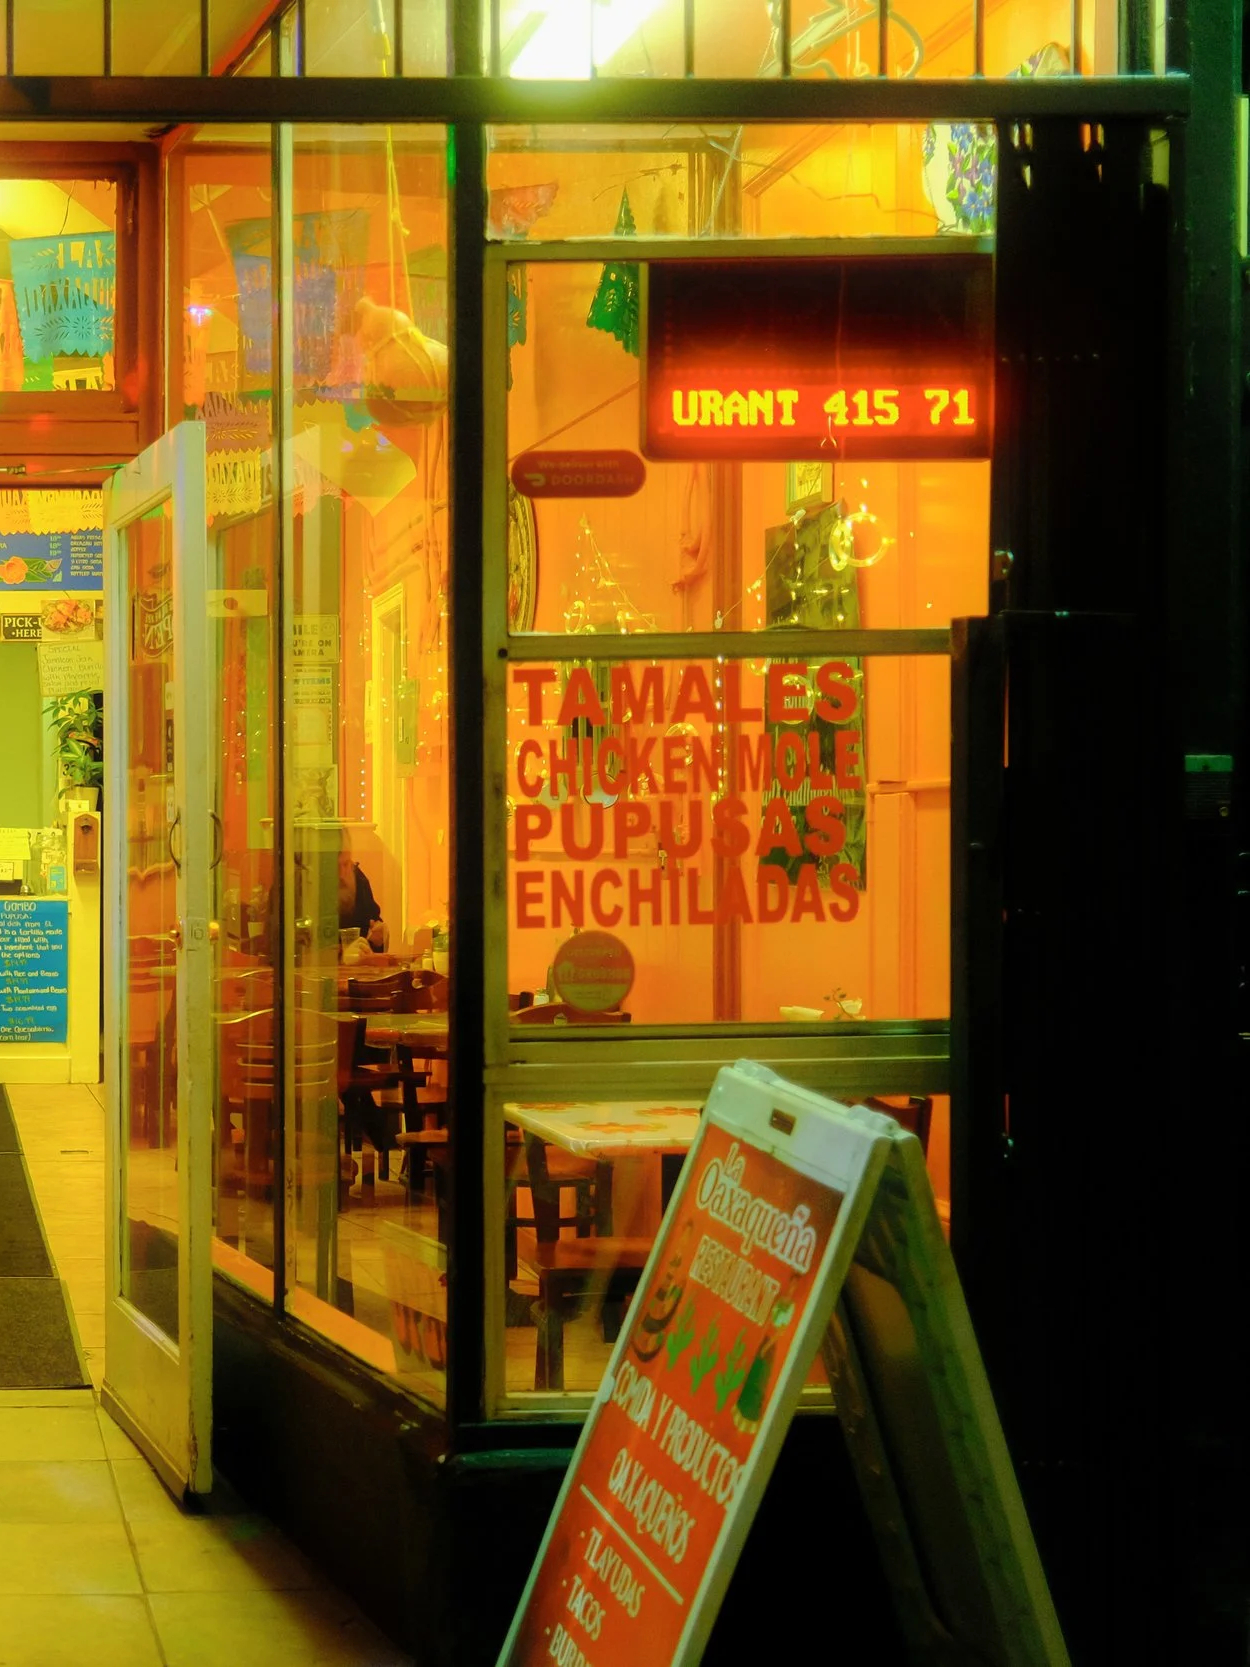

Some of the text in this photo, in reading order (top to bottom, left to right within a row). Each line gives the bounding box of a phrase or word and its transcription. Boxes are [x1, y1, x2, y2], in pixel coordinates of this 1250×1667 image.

[671, 388, 975, 427] URANT 415 71
[15, 629, 42, 638] HERE
[318, 639, 332, 647] ON
[513, 661, 859, 727] TAMALES
[516, 730, 863, 799] CHICKEN MOLE
[513, 795, 847, 862] PUPUSAS
[514, 861, 861, 930] ENCHILADAS
[695, 1156, 818, 1274] Oaxaqueña
[611, 1359, 750, 1506] COMIDA Y PRODUCTOS
[583, 1526, 646, 1618] TLAYUDAS
[565, 1574, 606, 1641] TACOS
